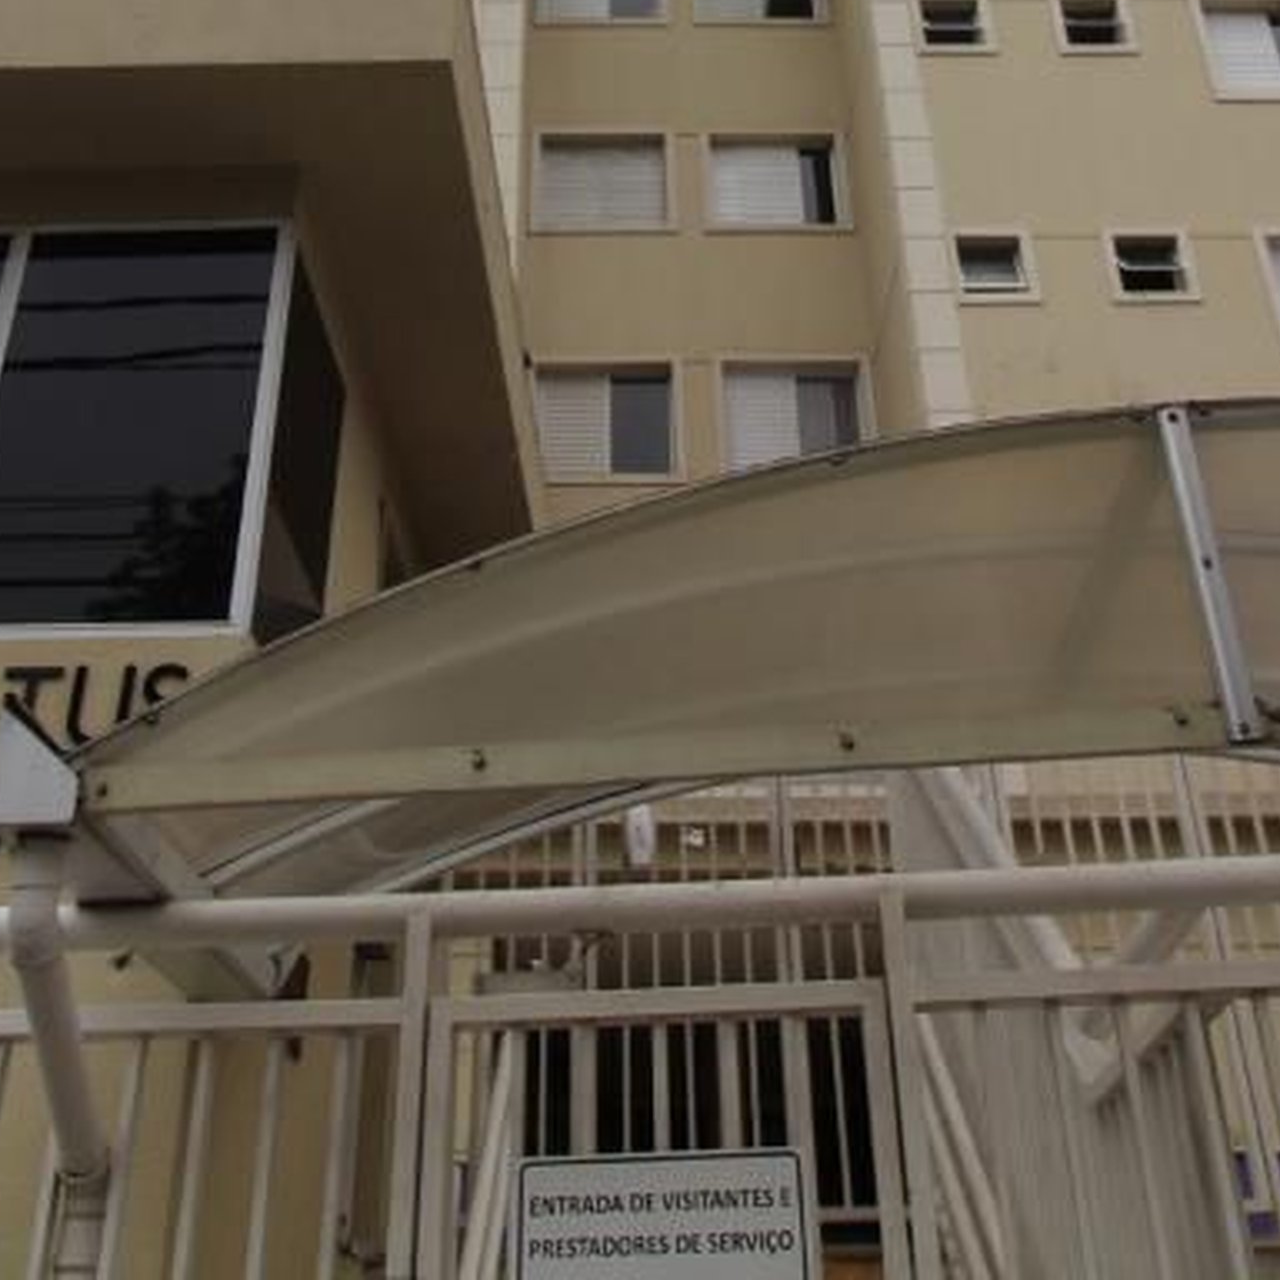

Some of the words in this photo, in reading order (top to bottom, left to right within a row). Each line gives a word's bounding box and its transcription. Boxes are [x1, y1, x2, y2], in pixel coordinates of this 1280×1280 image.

[528, 1194, 623, 1218] ENTRADA
[629, 1193, 656, 1214] DE
[662, 1188, 774, 1212] VISITANTES
[528, 1234, 670, 1260] PRESTADORES
[675, 1232, 703, 1254] DE
[706, 1229, 795, 1254] SERVIÇO
